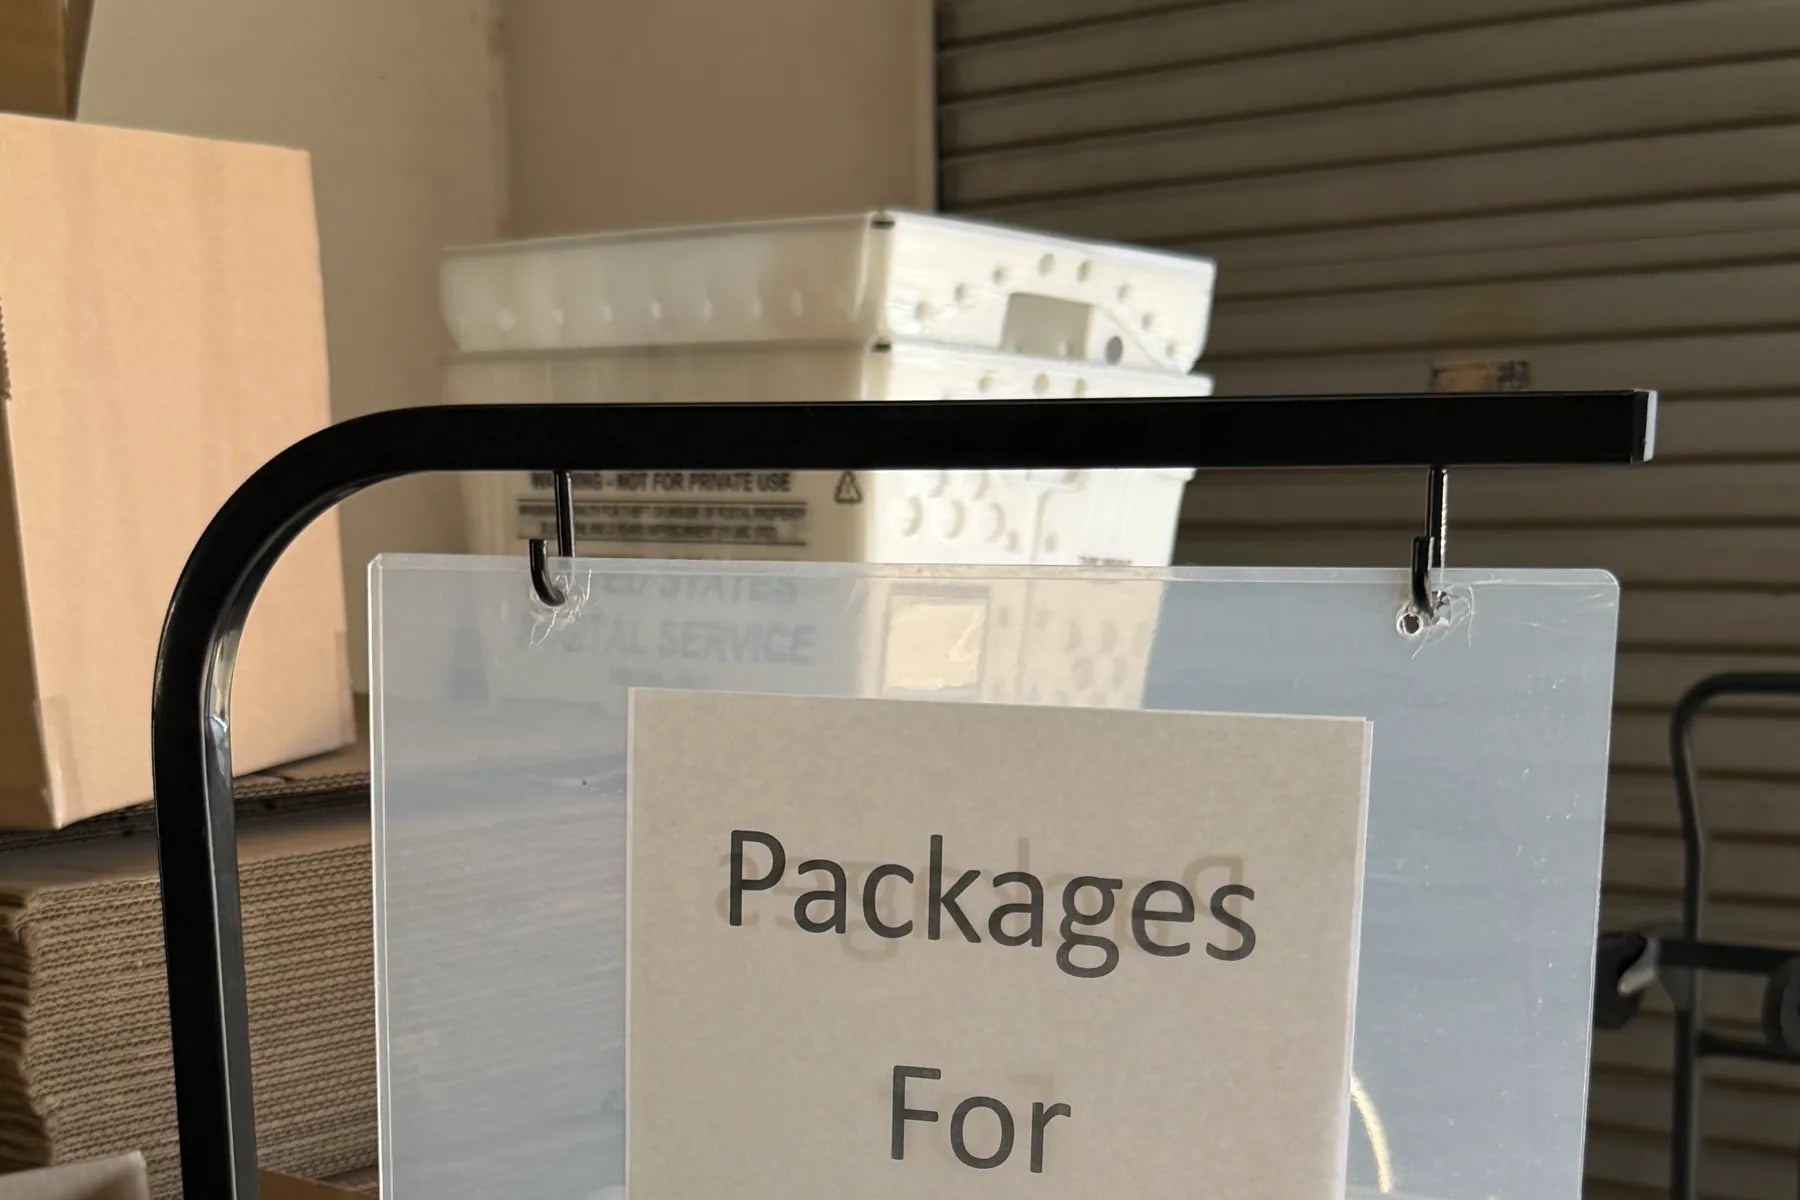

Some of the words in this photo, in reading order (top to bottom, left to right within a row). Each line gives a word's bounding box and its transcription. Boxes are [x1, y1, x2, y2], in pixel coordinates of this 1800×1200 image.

[653, 472, 684, 491] FOR
[757, 472, 791, 492] USE
[729, 829, 1256, 978] Packages
[890, 1064, 1071, 1174] For
